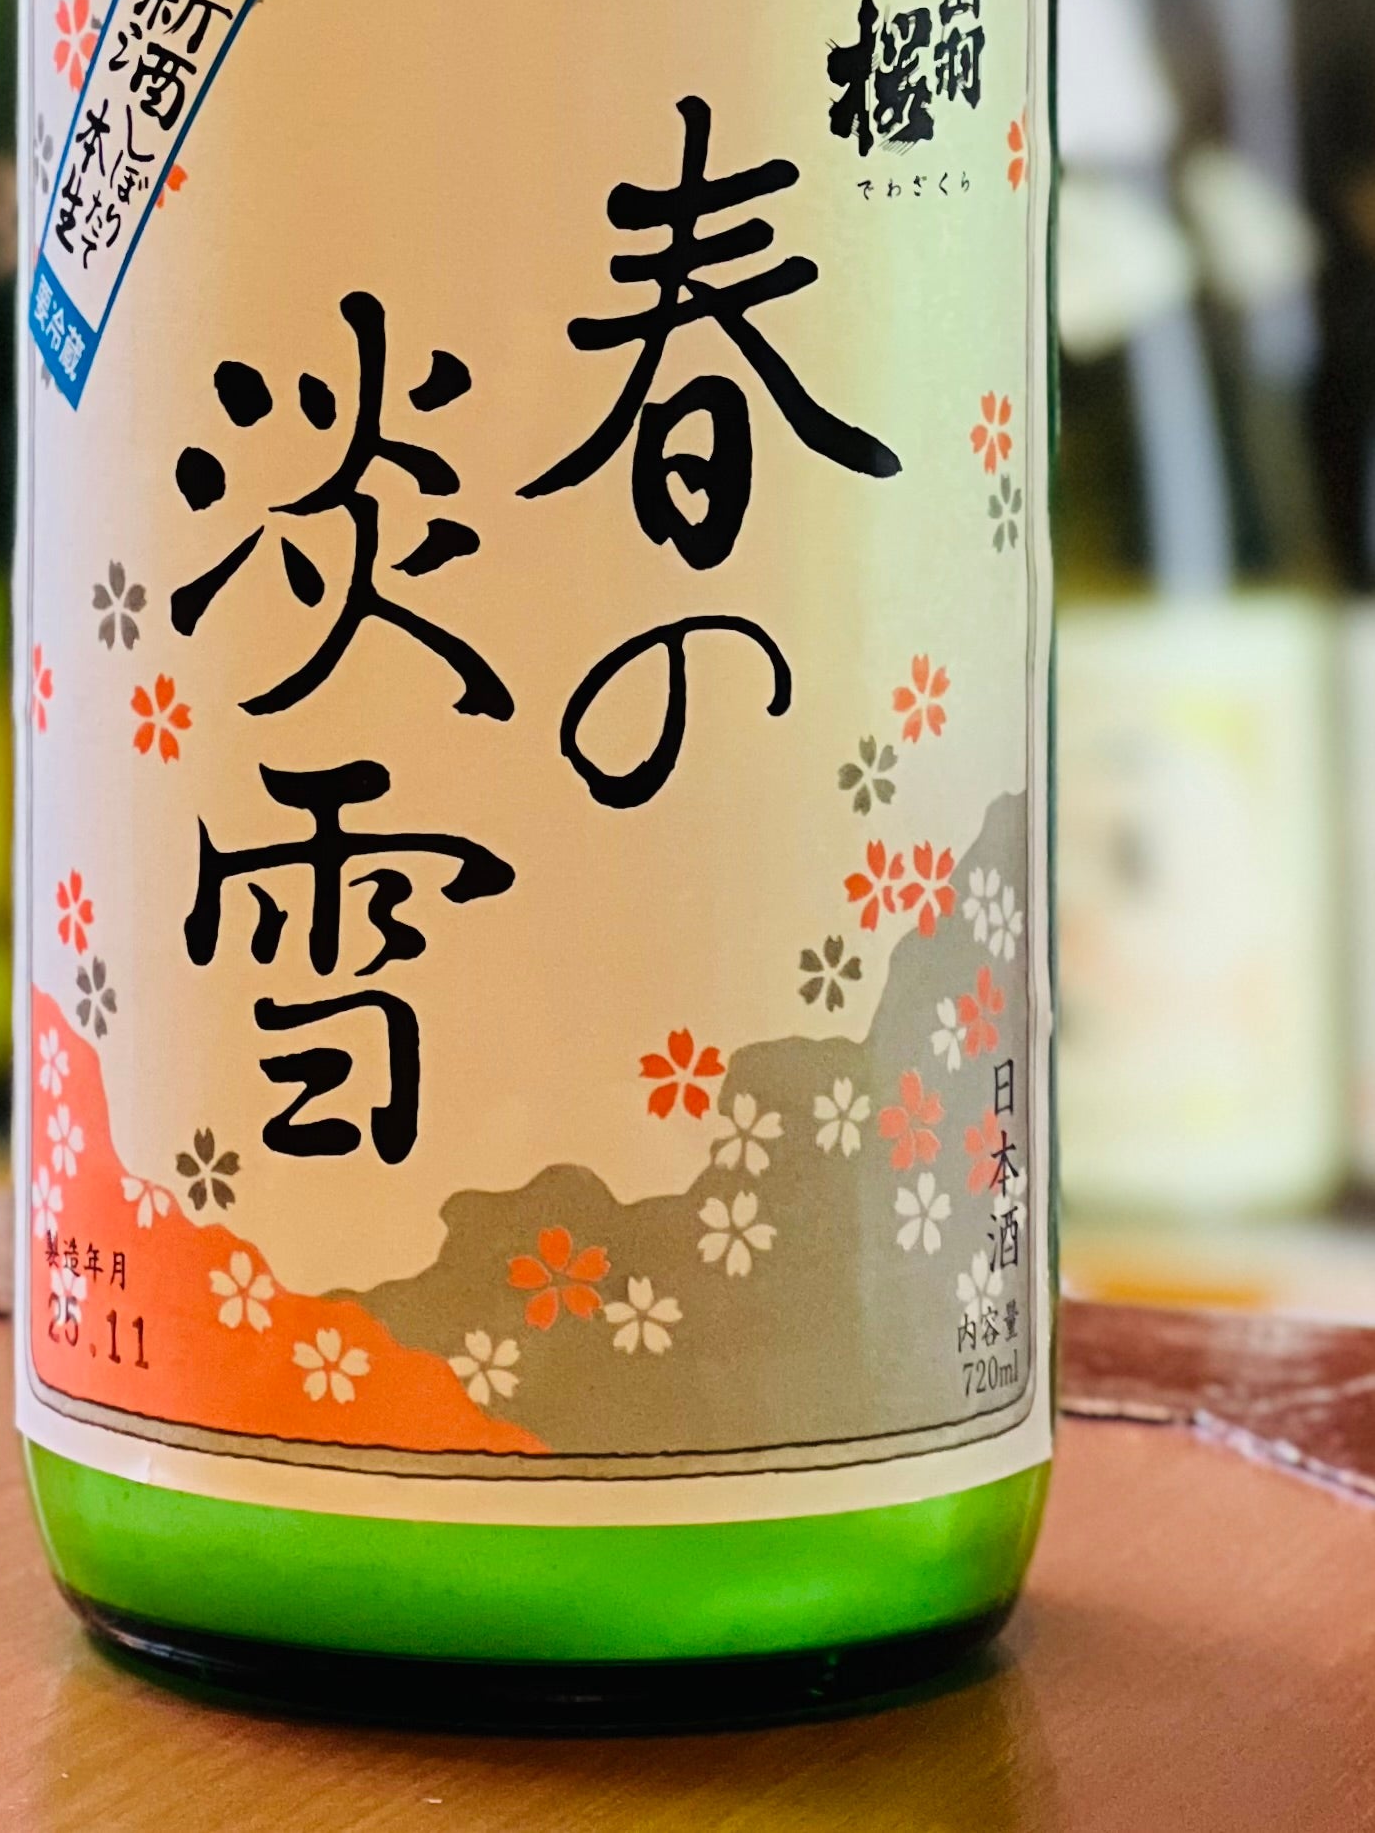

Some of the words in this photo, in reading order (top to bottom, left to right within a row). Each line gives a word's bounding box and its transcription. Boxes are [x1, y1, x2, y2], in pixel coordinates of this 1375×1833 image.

[55, 98, 110, 254] 本生
[857, 171, 971, 201] でわざくら
[34, 273, 86, 382] 要冷蔵
[515, 95, 902, 809] 春の
[170, 291, 516, 1165] 淡雪
[988, 1059, 1019, 1273] 日本酒
[48, 1291, 149, 1370] 25.11
[957, 1299, 1019, 1353] 内容量
[961, 1349, 1020, 1398] 720ml
